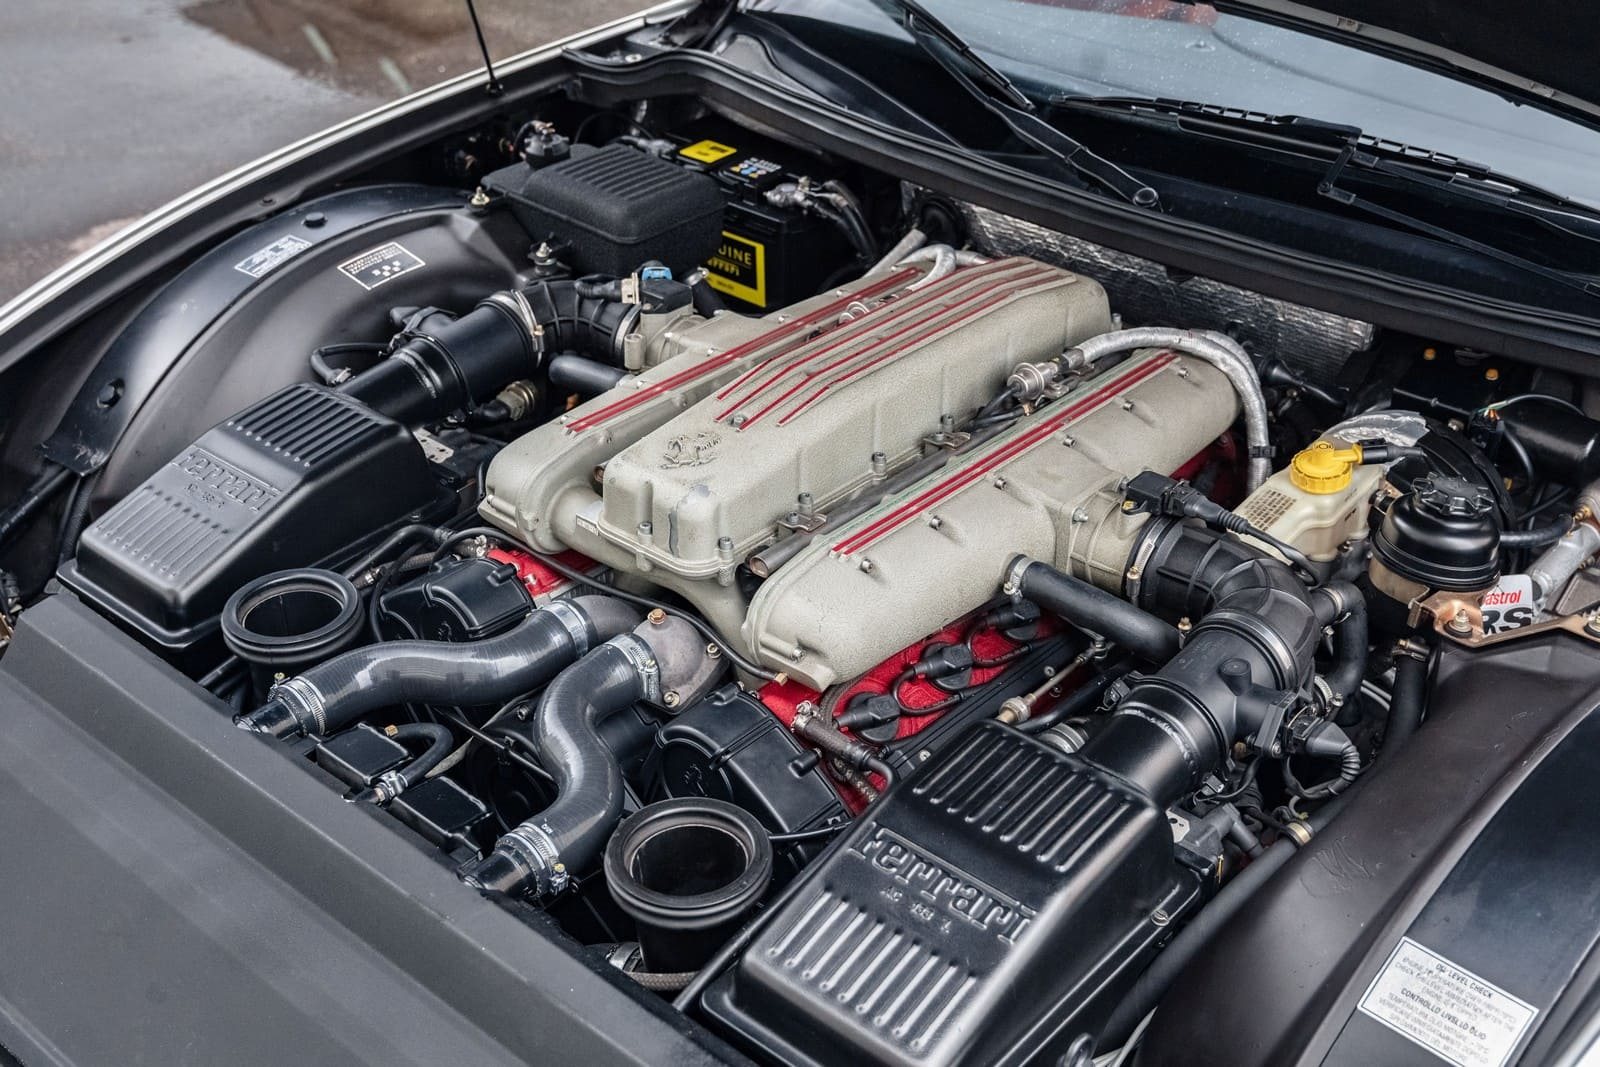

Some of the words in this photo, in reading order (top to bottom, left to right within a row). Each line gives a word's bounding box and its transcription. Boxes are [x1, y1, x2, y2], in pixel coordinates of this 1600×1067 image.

[1484, 590, 1522, 605] astrol
[847, 821, 1038, 945] Ferrari
[1447, 970, 1469, 985] LEVEL
[1468, 981, 1493, 998] CHECK
[1399, 987, 1441, 1014] CONTROLLO
[1440, 1010, 1470, 1030] LIVELLO
[1468, 1025, 1488, 1040] OLIO
